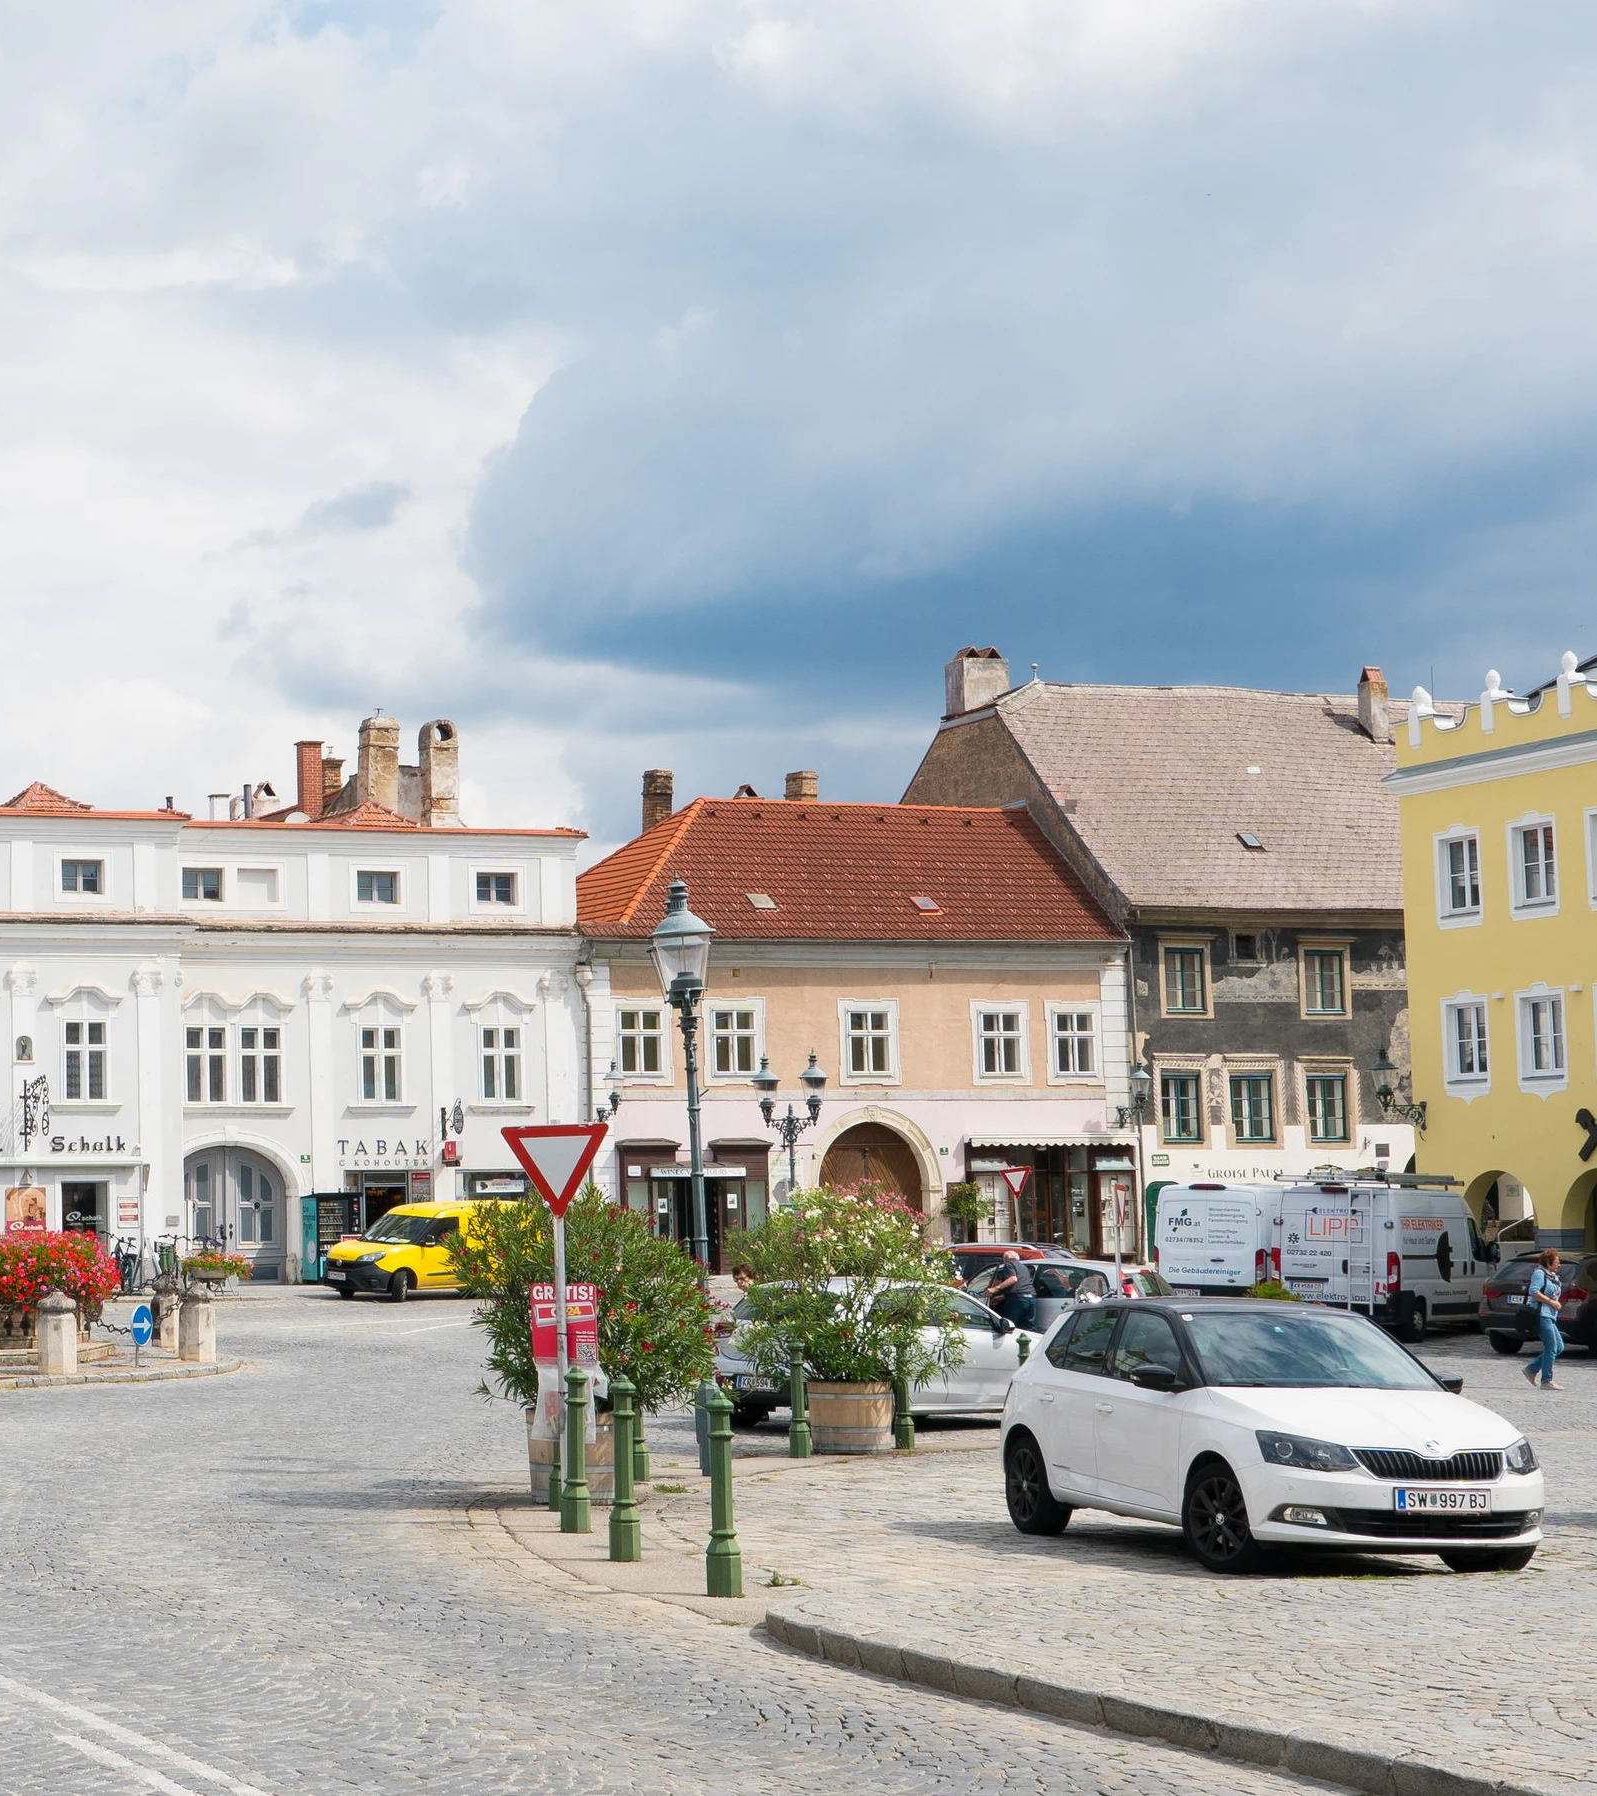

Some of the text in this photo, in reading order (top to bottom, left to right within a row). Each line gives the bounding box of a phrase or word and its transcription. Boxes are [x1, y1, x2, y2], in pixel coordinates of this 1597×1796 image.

[51, 1136, 126, 1152] Schalk
[337, 1139, 428, 1156] TABAK
[354, 1159, 428, 1167] KOHOUTEK
[1310, 1217, 1359, 1236] LIPP
[1181, 1266, 1242, 1277] Gebäudereiniger
[532, 1285, 594, 1300] GRTIS!
[1407, 1492, 1487, 1509] SW 997 BJ
